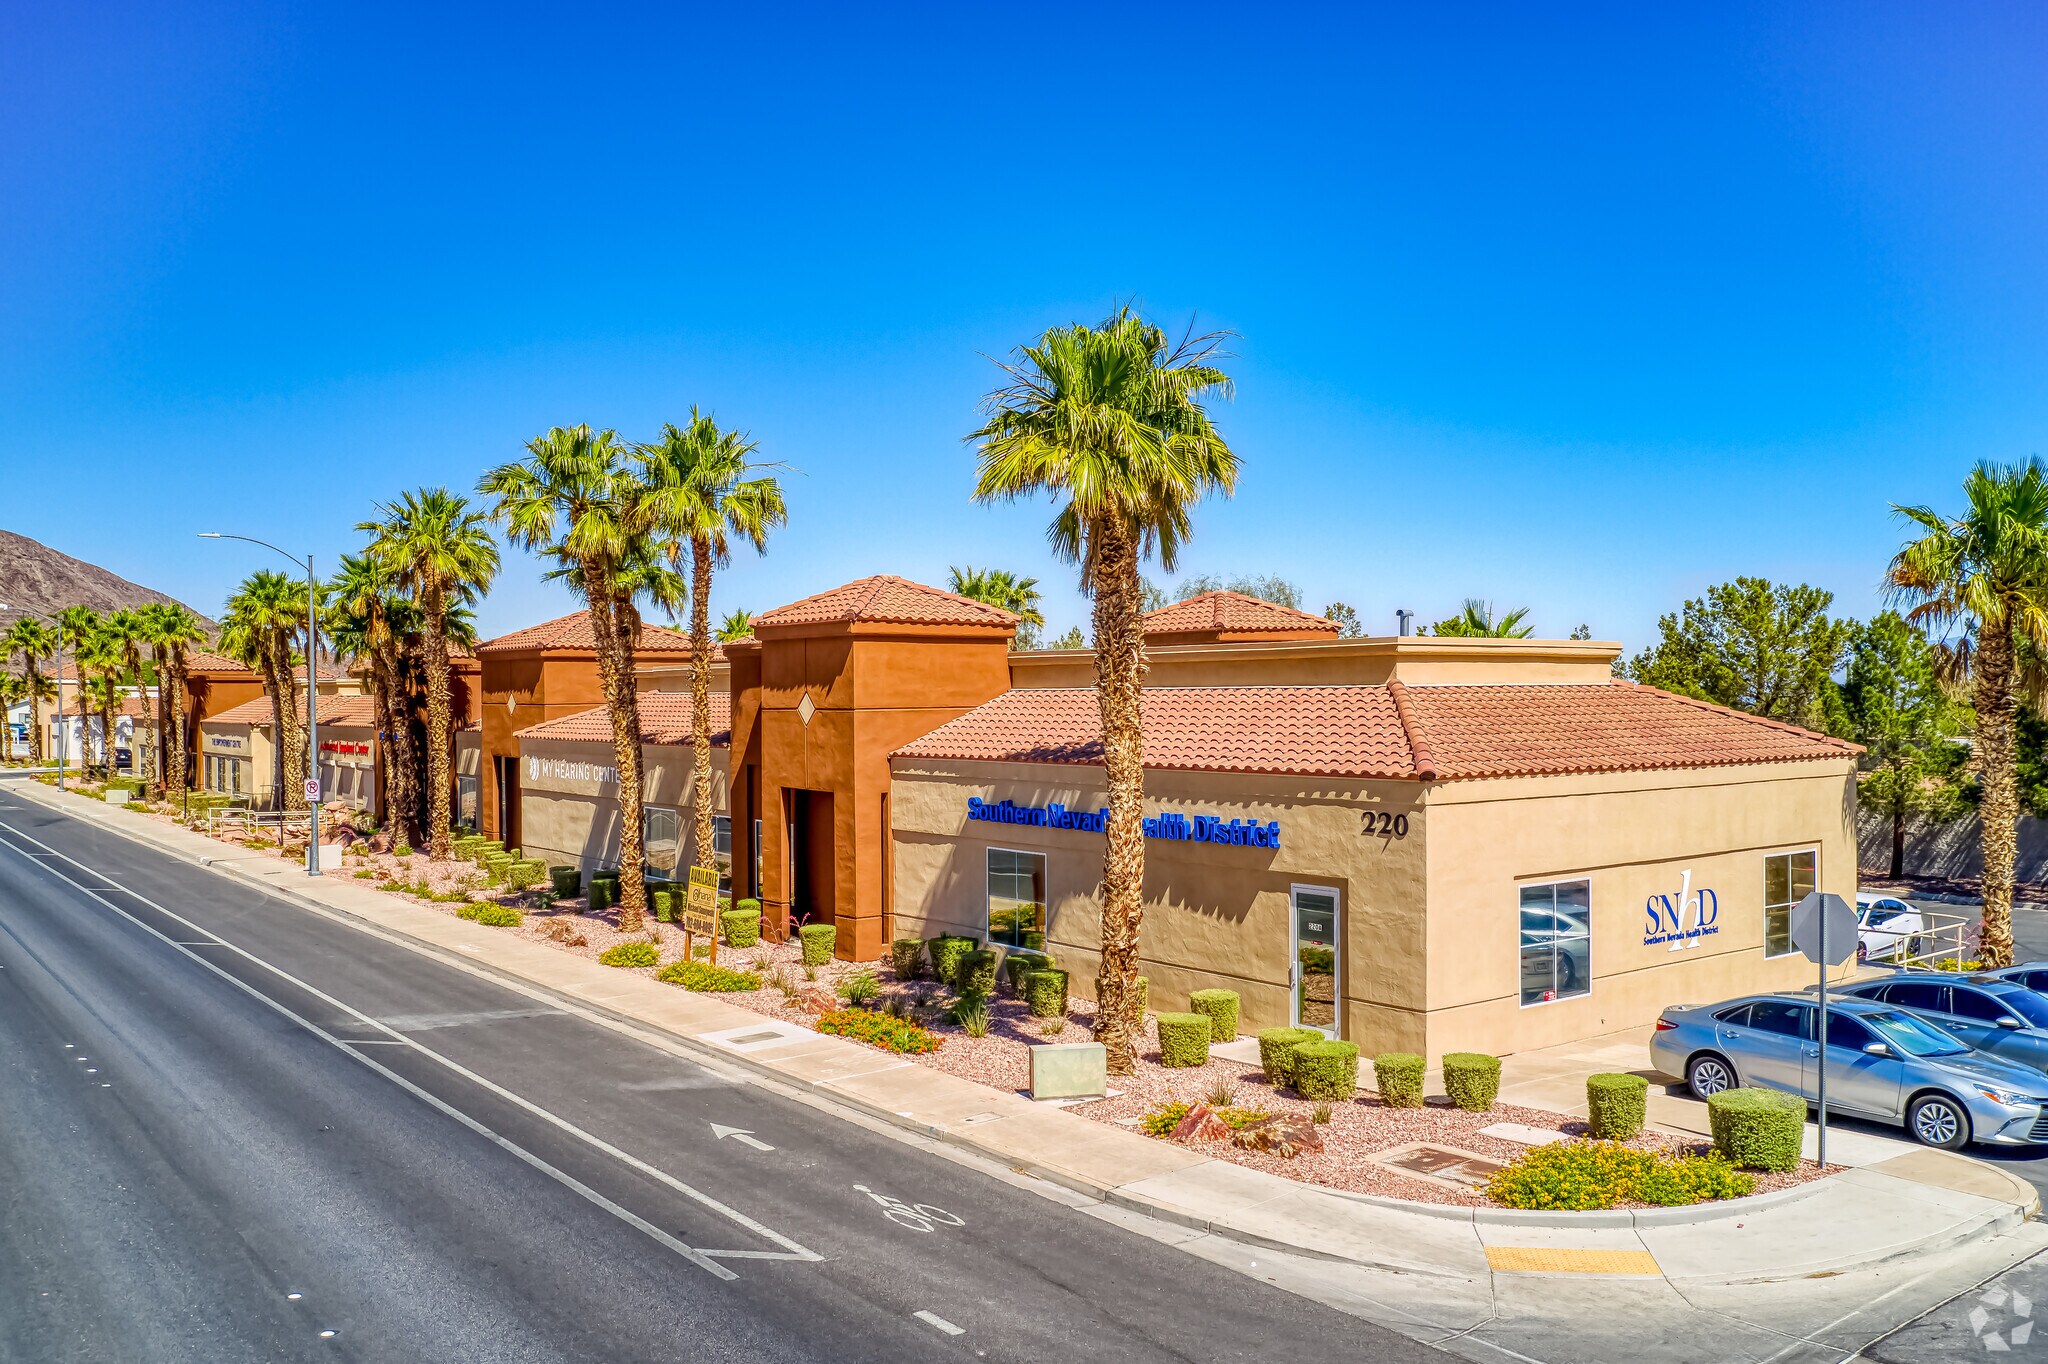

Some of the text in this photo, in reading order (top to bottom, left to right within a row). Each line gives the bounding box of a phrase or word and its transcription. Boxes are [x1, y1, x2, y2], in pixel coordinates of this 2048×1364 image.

[543, 762, 620, 783] MY HEARING CENTE
[968, 797, 1280, 849] Southern Nevad ealth District
[1361, 811, 1409, 837] 220
[691, 868, 718, 887] AVAILABLE
[1644, 926, 1718, 945] Southern Nevada Health District
